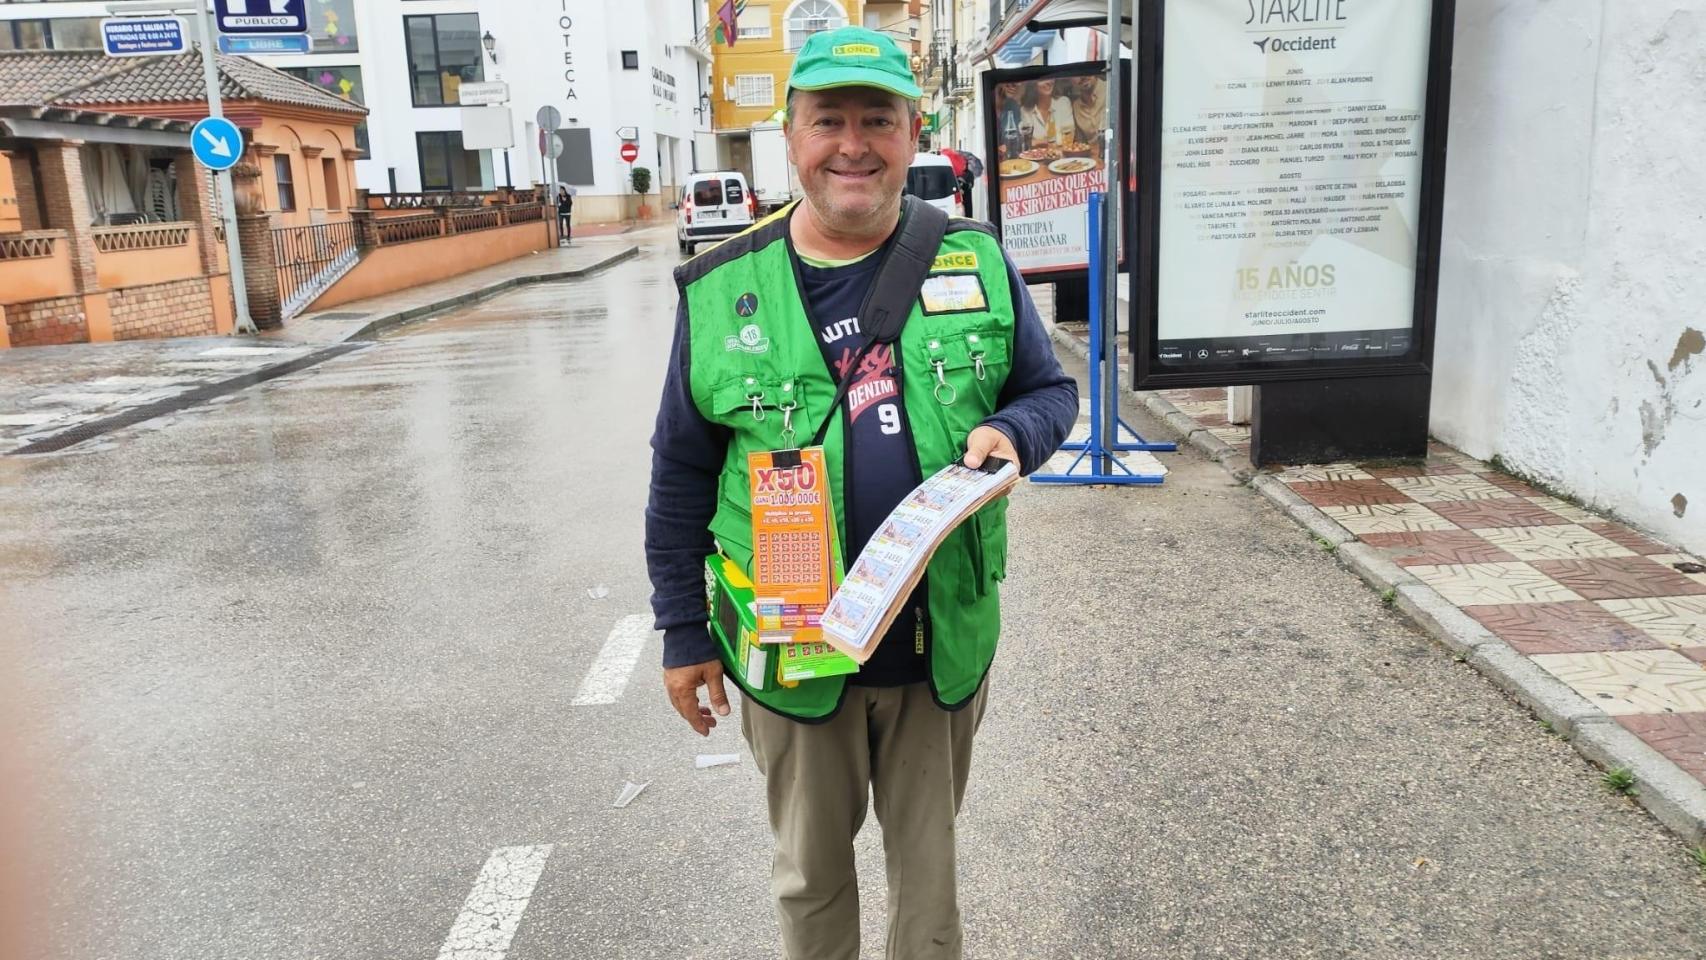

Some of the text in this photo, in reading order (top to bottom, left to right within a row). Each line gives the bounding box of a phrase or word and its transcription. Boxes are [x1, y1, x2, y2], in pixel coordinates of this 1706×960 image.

[1272, 36, 1336, 52] Occident
[1007, 177, 1064, 202] MOMENTOS
[1066, 172, 1087, 190] QUE
[1089, 169, 1104, 186] SO
[1006, 201, 1021, 220] SE
[1022, 194, 1057, 214] SIRVEN
[1058, 190, 1071, 207] EN
[1005, 220, 1054, 237] PARTICIPA Y
[1040, 233, 1067, 247] GANAR
[934, 255, 974, 267] ONCE
[1236, 260, 1336, 290] 15 AÑOS
[1245, 308, 1326, 318] starliteoccident.com
[848, 379, 894, 412] DENIM
[878, 403, 900, 435] 9
